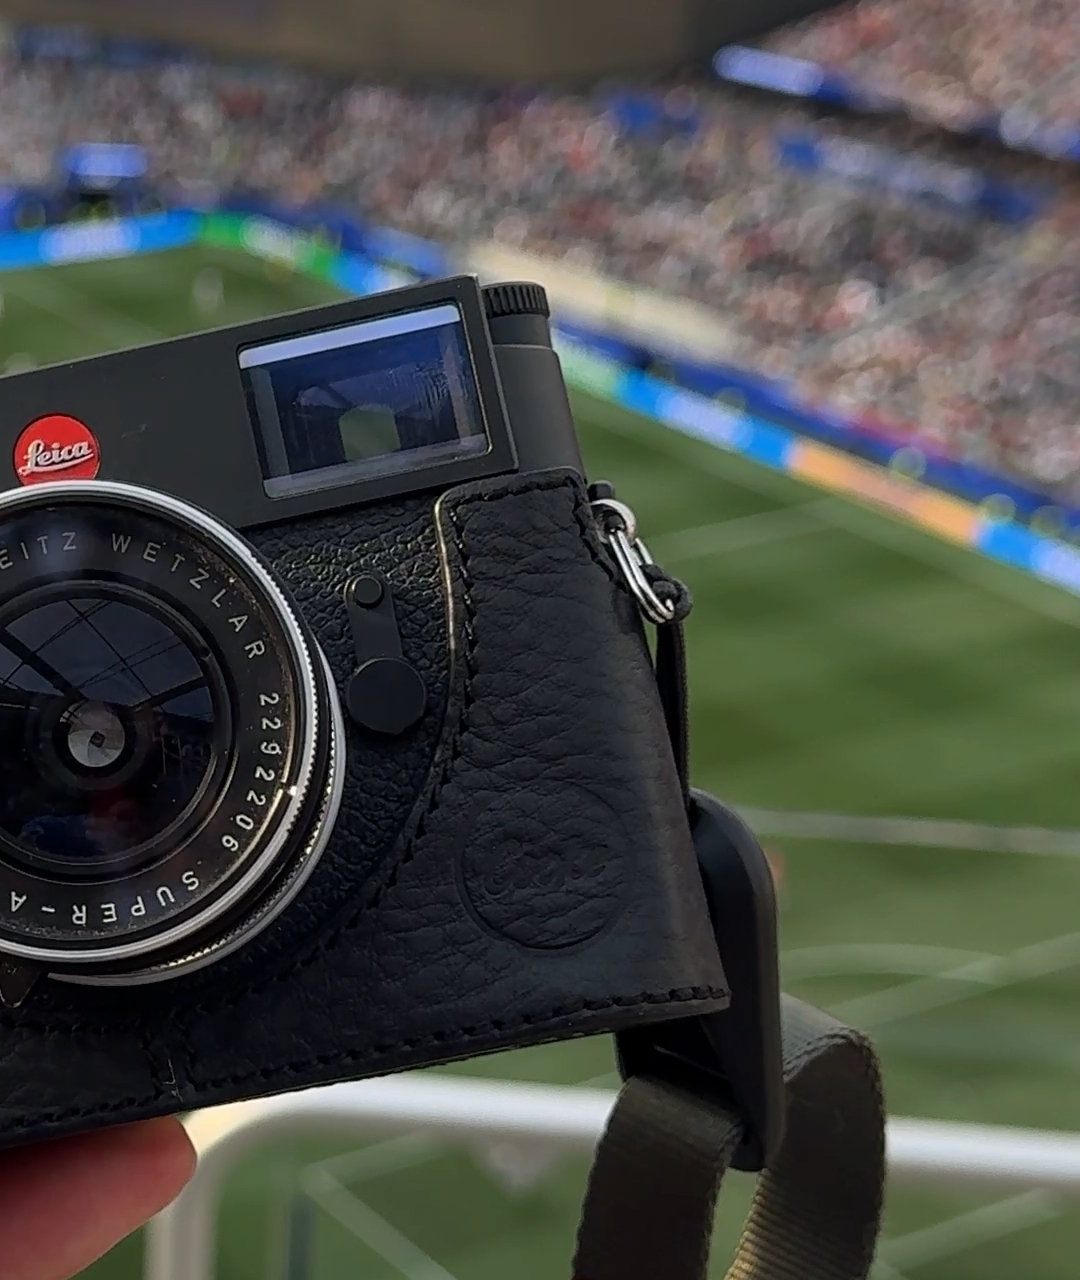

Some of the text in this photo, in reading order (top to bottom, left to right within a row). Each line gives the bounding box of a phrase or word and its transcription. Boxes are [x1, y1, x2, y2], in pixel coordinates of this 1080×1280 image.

[19, 439, 94, 477] Leica
[111, 532, 266, 660] WETZLAR
[221, 692, 282, 852] 2292206
